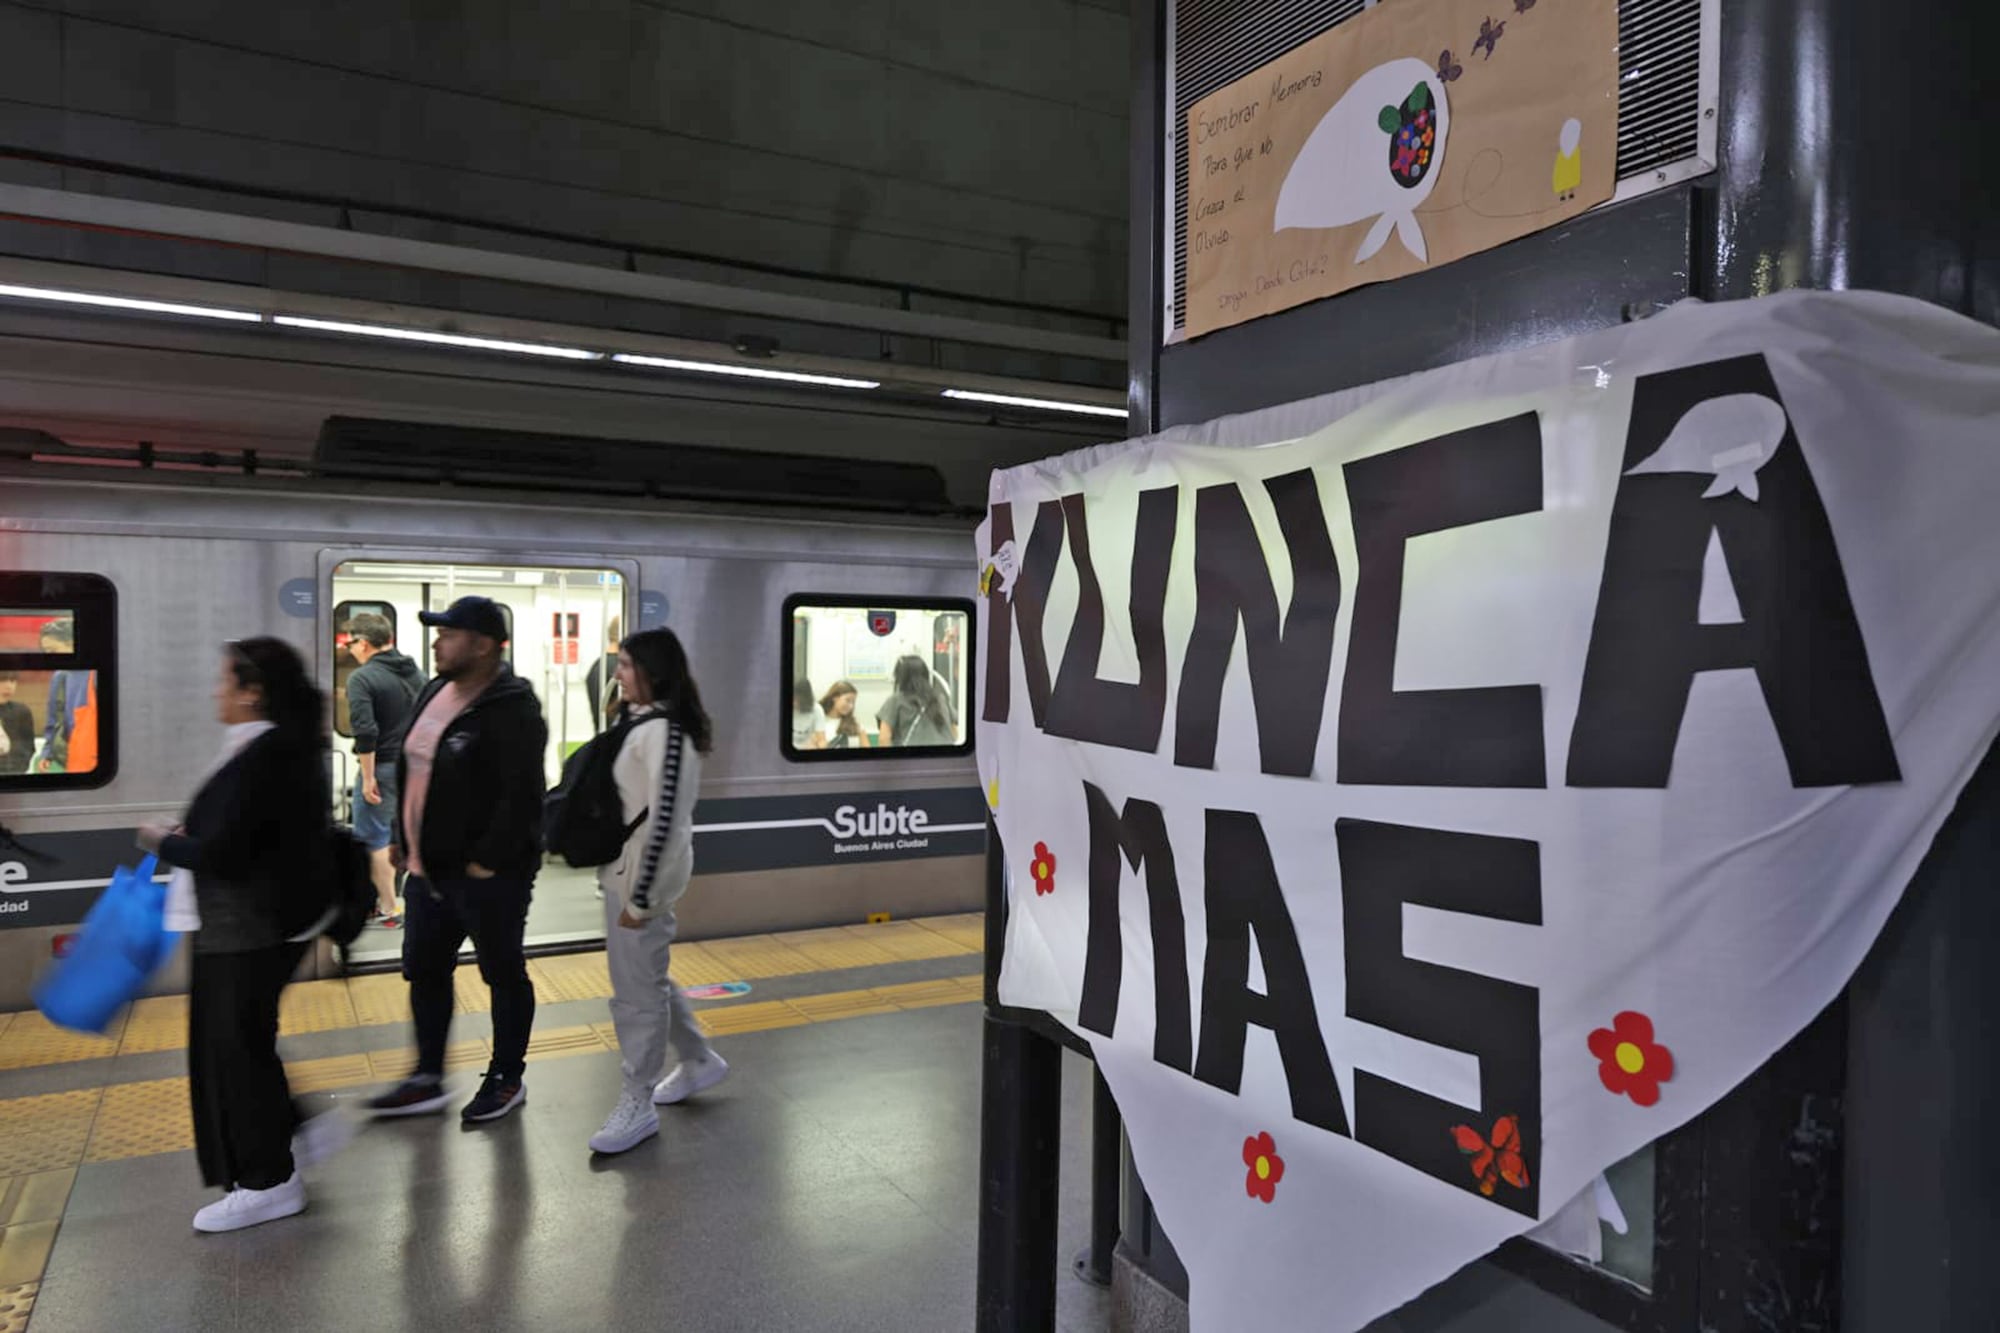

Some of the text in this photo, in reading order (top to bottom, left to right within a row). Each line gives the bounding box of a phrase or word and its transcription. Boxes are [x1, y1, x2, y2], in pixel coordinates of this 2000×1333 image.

[1196, 71, 1322, 144] Sembrar Memoria
[982, 352, 1902, 789] NUNCA
[834, 838, 929, 853] Buenos Aires Ciudad
[835, 803, 928, 838] Subte
[0, 899, 29, 913] dad
[1078, 780, 1542, 1220] MAS
